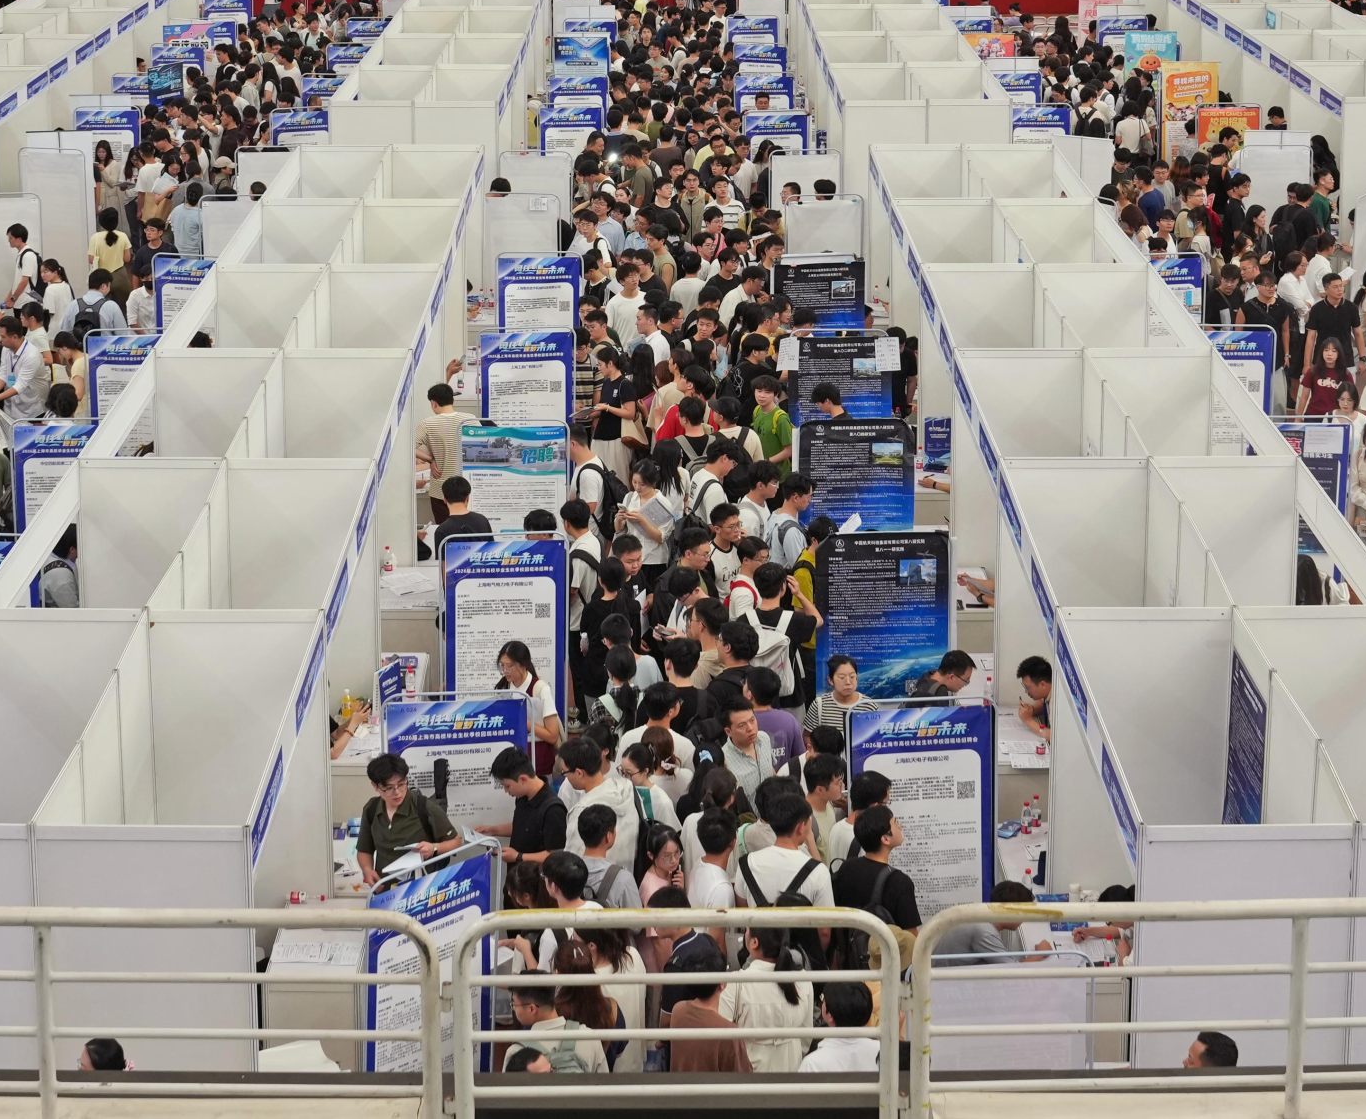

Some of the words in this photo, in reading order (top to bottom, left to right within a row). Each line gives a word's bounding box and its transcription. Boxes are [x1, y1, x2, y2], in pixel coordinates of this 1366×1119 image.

[521, 447, 554, 465] 招聘
[862, 737, 978, 748] 2026届上海市高校毕业生秋季校园现场招聘会
[426, 747, 492, 757] 上海电气集团股份有限公司
[895, 756, 949, 764] 上海航天电子有限公司
